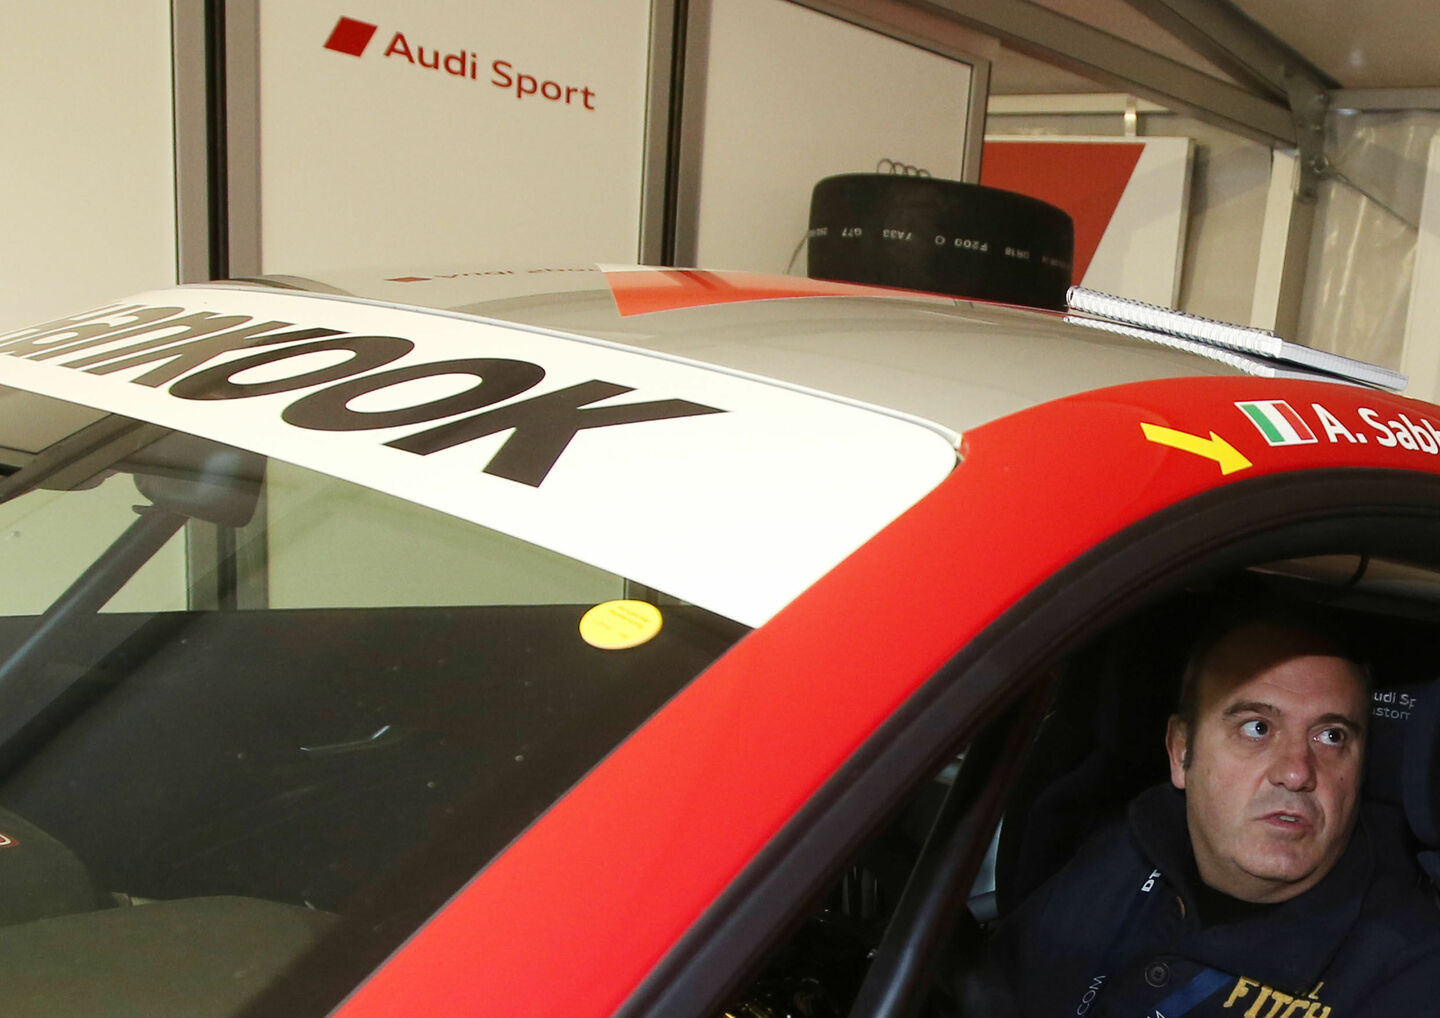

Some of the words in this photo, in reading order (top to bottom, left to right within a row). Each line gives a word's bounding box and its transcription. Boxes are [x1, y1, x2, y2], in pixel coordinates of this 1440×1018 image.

[384, 31, 478, 80] Audi
[491, 59, 596, 110] Sport
[1311, 403, 1368, 444] A.
